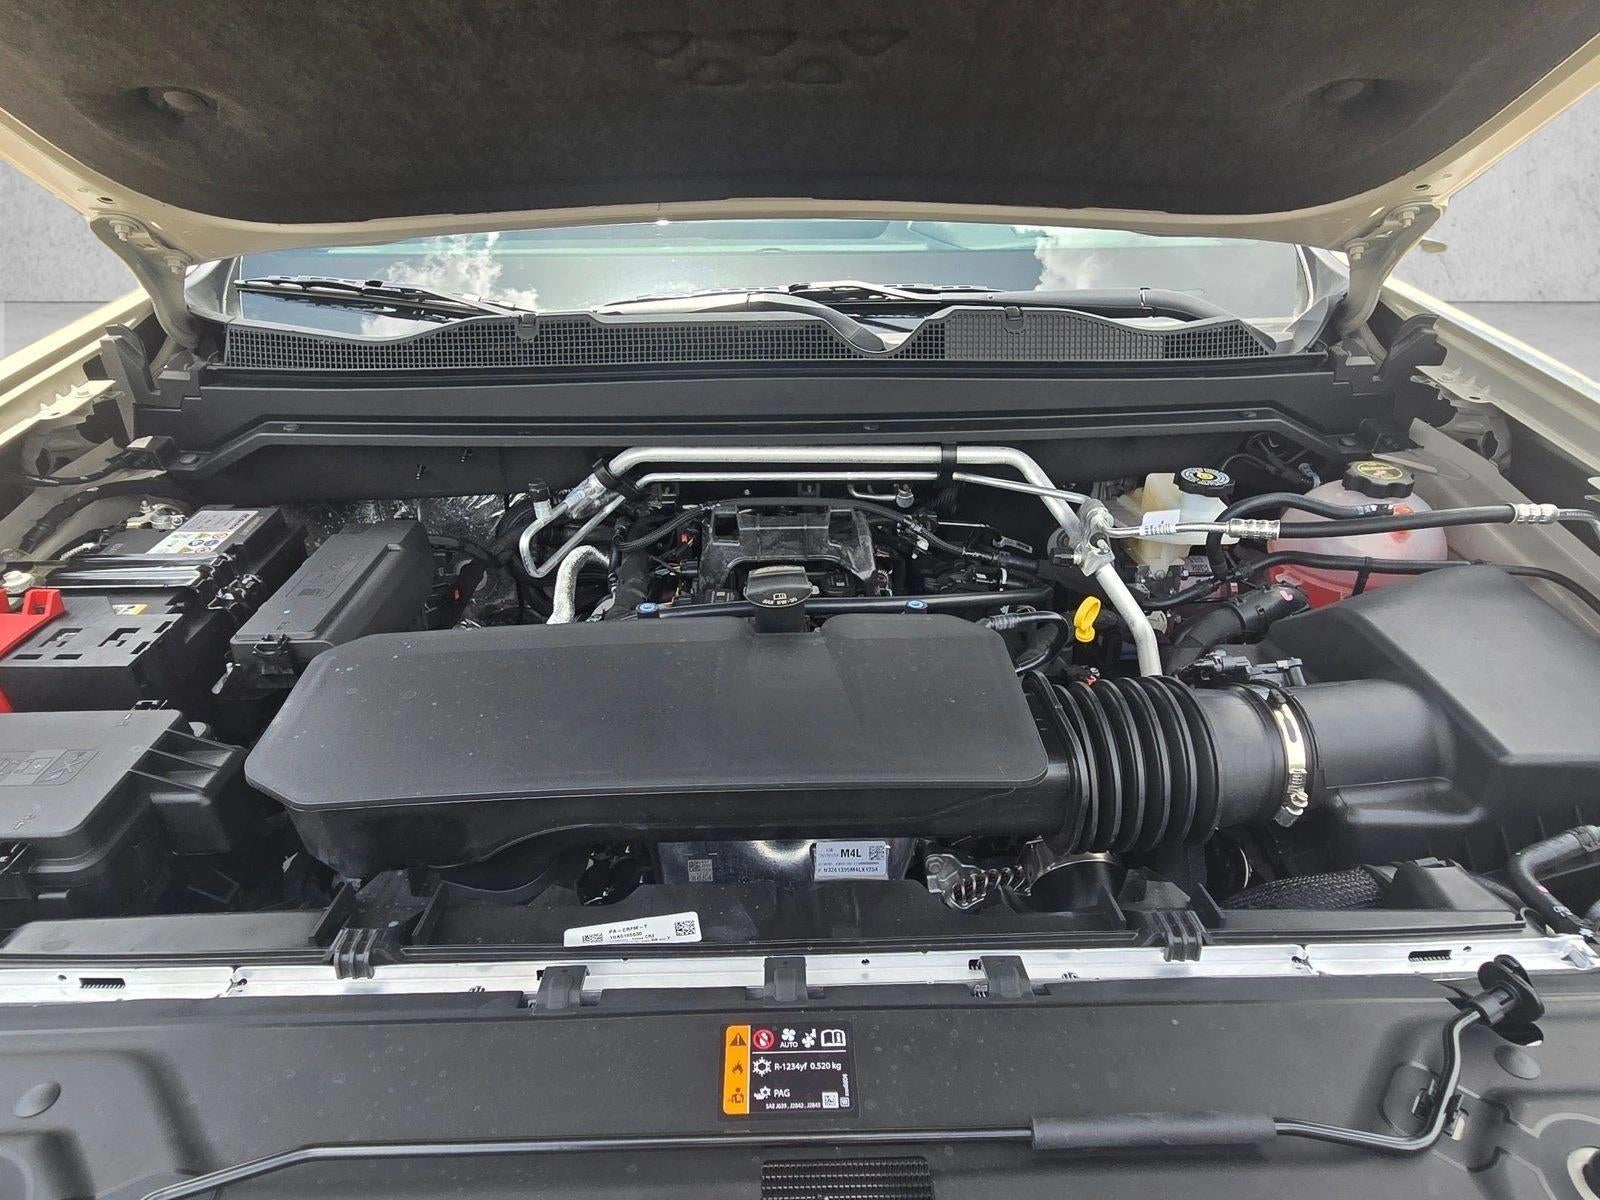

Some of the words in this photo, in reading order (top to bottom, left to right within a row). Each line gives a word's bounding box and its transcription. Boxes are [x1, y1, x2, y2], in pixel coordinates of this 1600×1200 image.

[840, 848, 862, 858] M4L
[774, 1062, 808, 1072] R-1234yf
[810, 1062, 831, 1070] 0.520
[832, 1061, 842, 1071] kg
[773, 1088, 791, 1098] PAG
